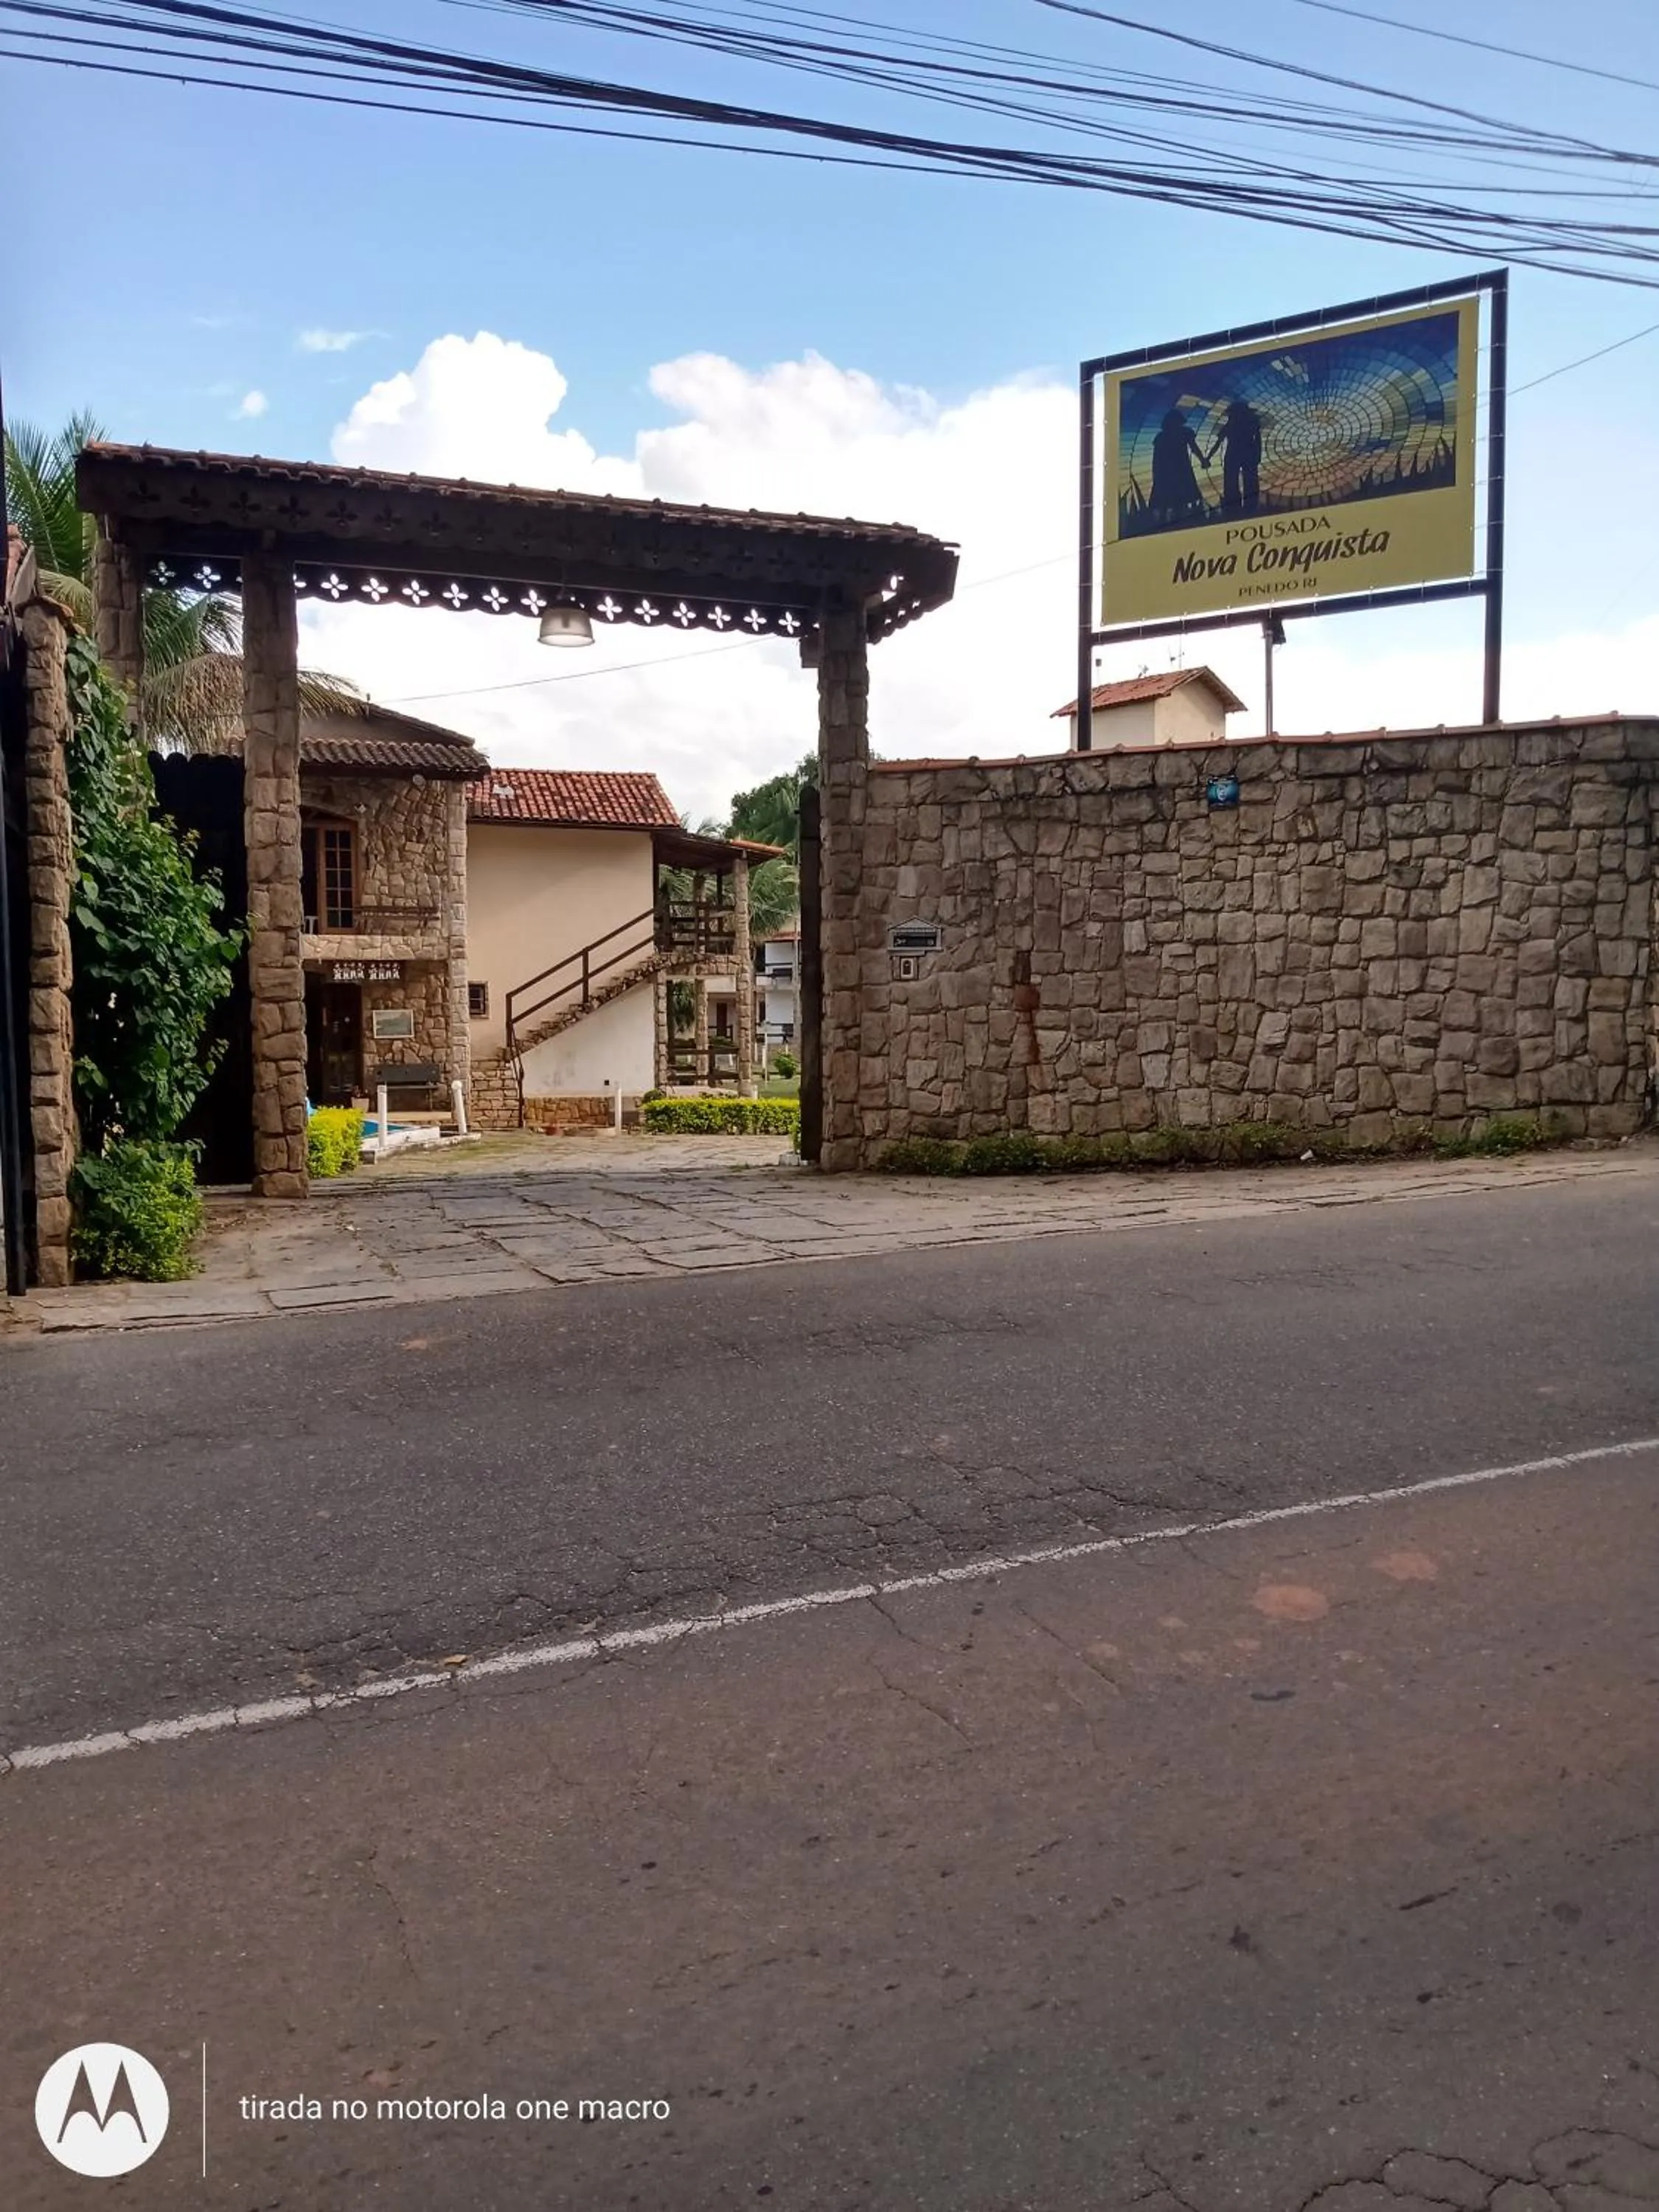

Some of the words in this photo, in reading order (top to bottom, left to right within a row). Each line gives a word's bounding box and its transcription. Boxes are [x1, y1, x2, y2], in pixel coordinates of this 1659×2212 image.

[1225, 515, 1330, 544] POUSADA
[1172, 552, 1237, 583] Nova
[1247, 528, 1391, 573] Conquista
[1239, 580, 1298, 597] PENEDO
